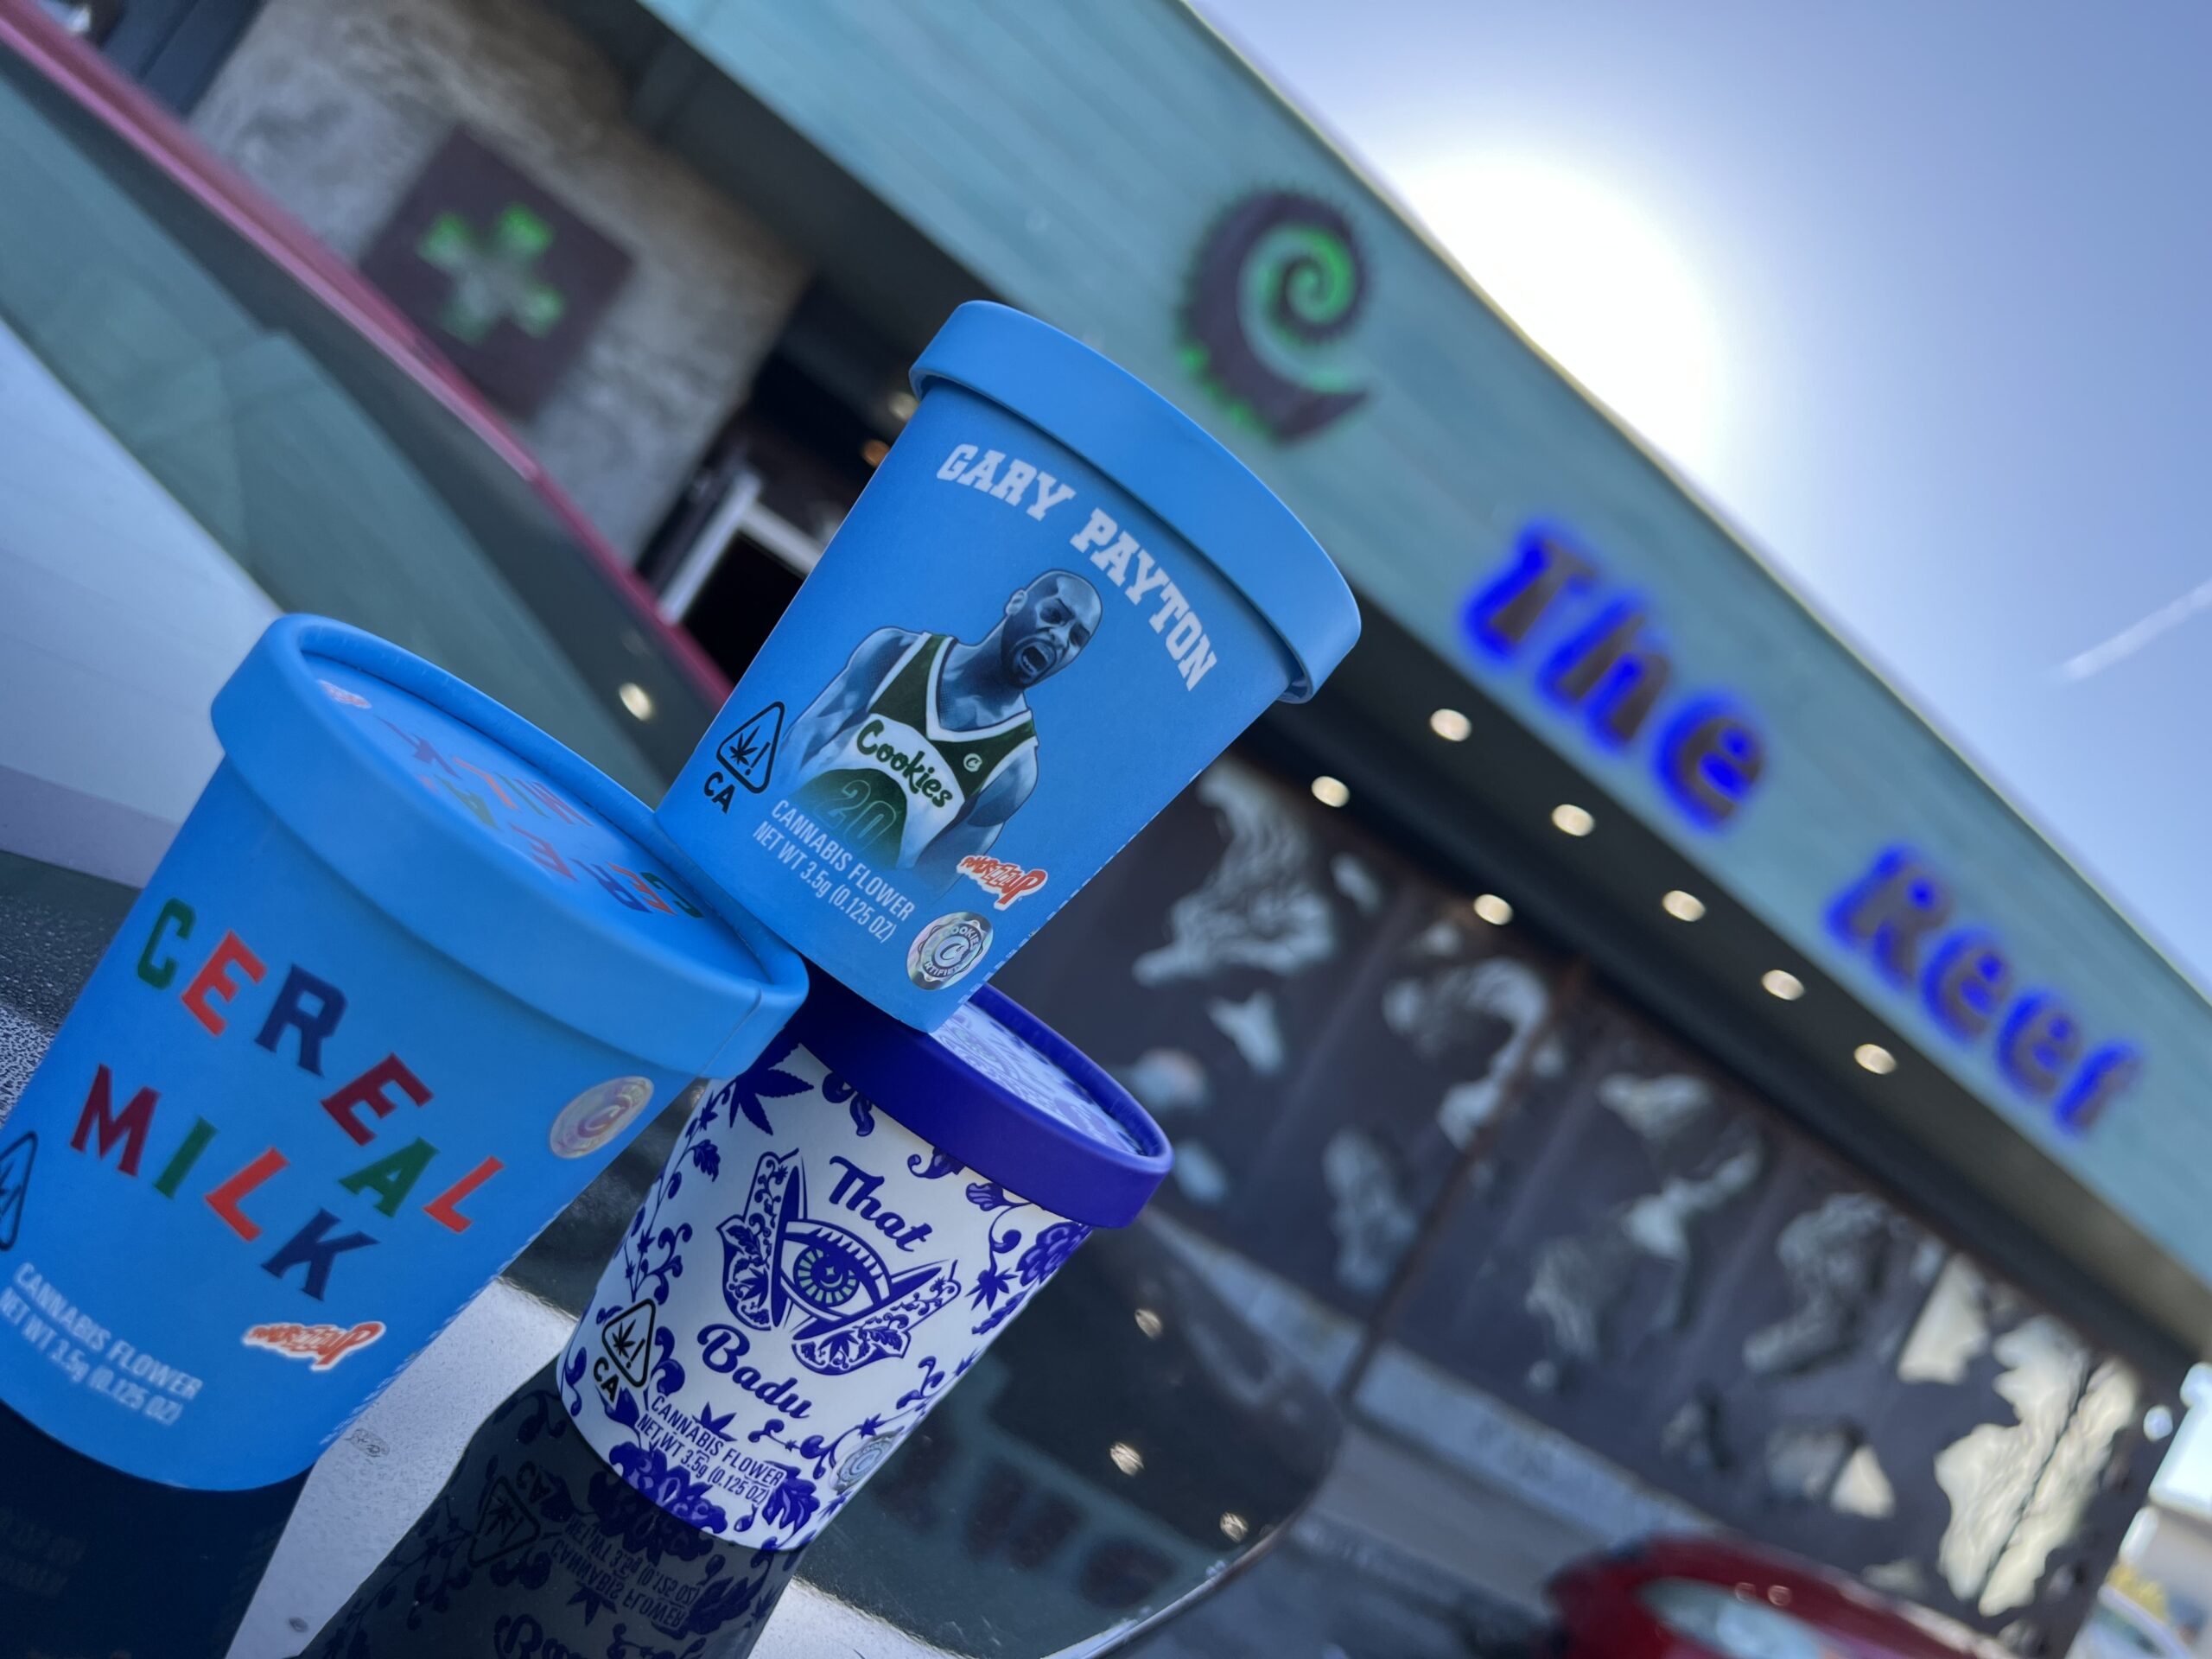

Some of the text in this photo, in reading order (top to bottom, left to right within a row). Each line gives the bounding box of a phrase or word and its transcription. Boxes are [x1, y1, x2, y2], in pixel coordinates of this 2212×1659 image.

[937, 443, 1217, 691] GARY PAYTON
[1469, 529, 1765, 823] The
[704, 771, 736, 814] CA
[856, 719, 953, 808] Cookies
[772, 800, 916, 922] CANNABIS FLOWER
[814, 779, 897, 853] 20
[753, 821, 898, 944] NET WT 3.5g (0.125 OZ)
[137, 898, 505, 1234] CEREAL
[70, 1064, 380, 1301] MILK
[829, 1155, 933, 1253] That
[15, 1262, 204, 1400] CANNABIS FLOWER
[594, 1357, 619, 1403] CA
[696, 1323, 813, 1419] Badu
[637, 1413, 771, 1505] NET WT 3.5g (0.125 OZ)
[651, 1395, 724, 1457] CANNABIS
[722, 1447, 785, 1486] FLOWER
